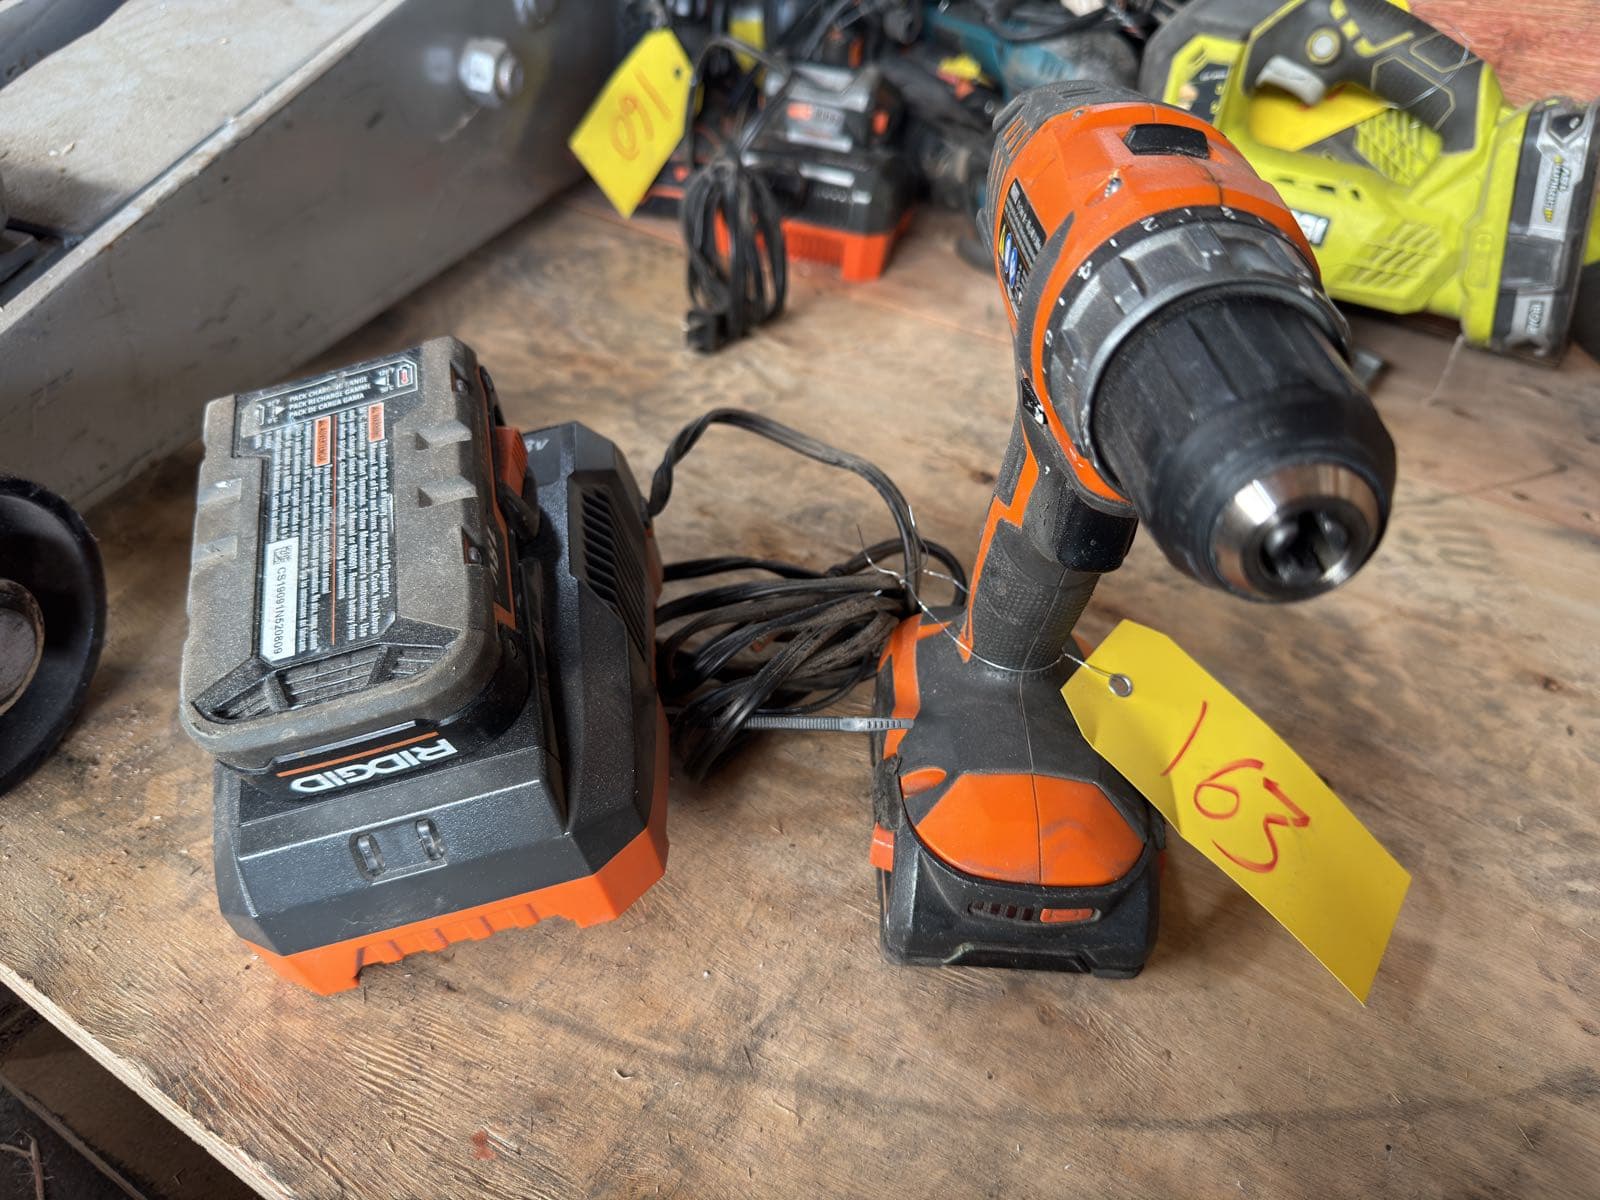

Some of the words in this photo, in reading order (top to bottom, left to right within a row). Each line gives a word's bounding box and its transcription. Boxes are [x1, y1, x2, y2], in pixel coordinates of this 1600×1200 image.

[608, 68, 674, 161] 160
[1139, 217, 1158, 232] 2
[1077, 260, 1092, 280] 4
[289, 401, 307, 410] PACK
[290, 738, 458, 793] RIDGID
[1160, 700, 1311, 873] 163
